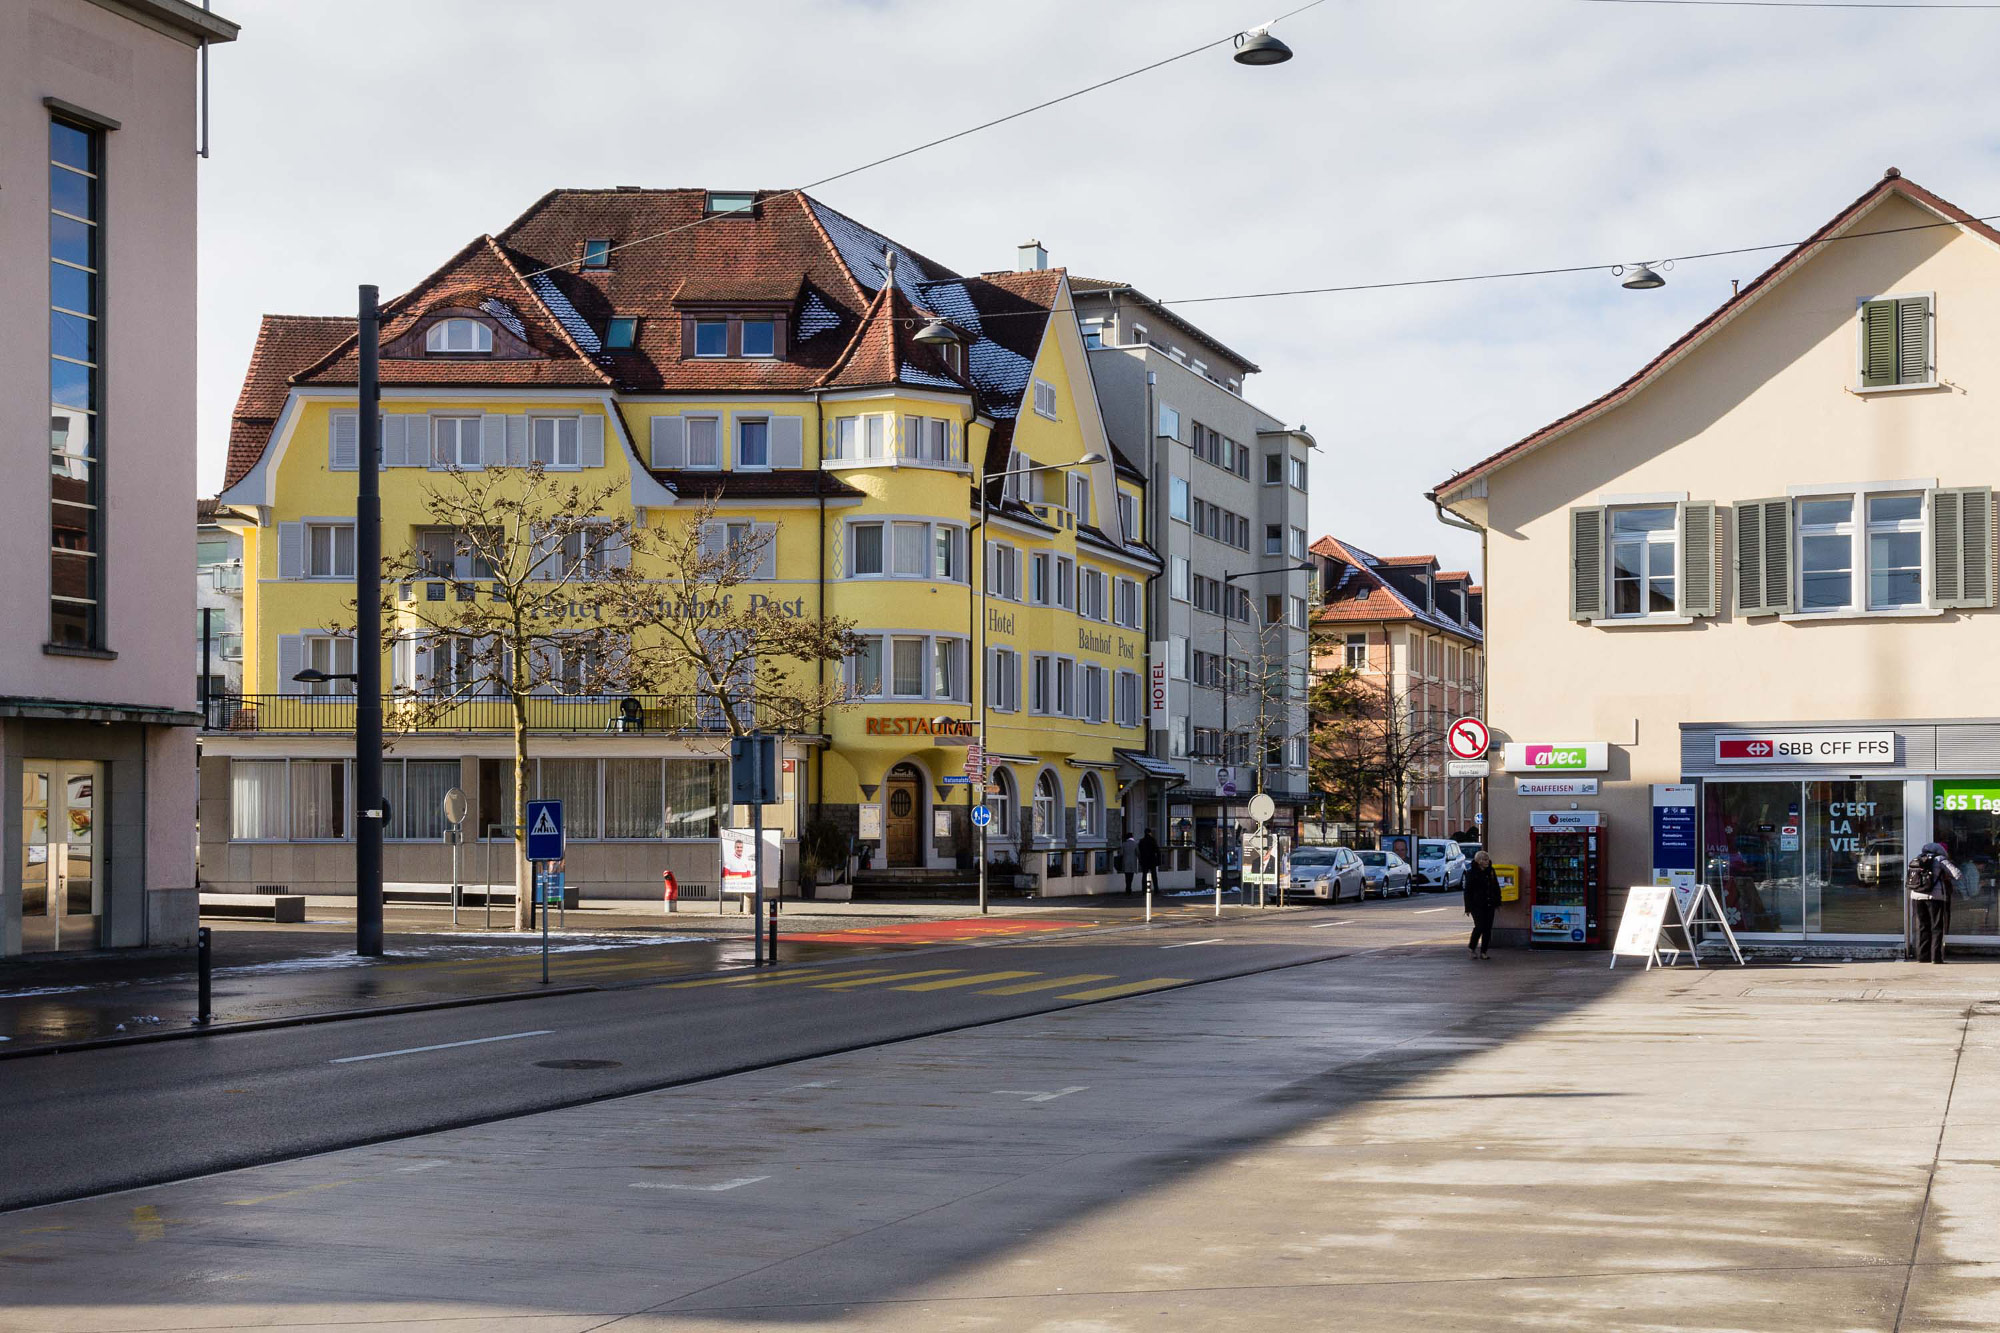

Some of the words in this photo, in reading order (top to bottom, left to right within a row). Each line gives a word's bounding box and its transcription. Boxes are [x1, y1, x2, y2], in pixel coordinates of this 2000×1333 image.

[988, 608, 1015, 636] Hotel
[1078, 627, 1112, 655] Bahnhof
[1118, 636, 1134, 660] Post
[1153, 661, 1164, 710] HOTEL
[1779, 742, 1813, 755] SBB
[1820, 741, 1852, 755] CFF
[1858, 740, 1889, 754] FFS
[1535, 751, 1582, 765] avec.
[1531, 784, 1574, 792] RAIFFEISEN
[1829, 802, 1877, 817] C'EST
[1934, 794, 1968, 811] 365
[1830, 820, 1852, 834] LA
[1830, 838, 1865, 852] VIE.
